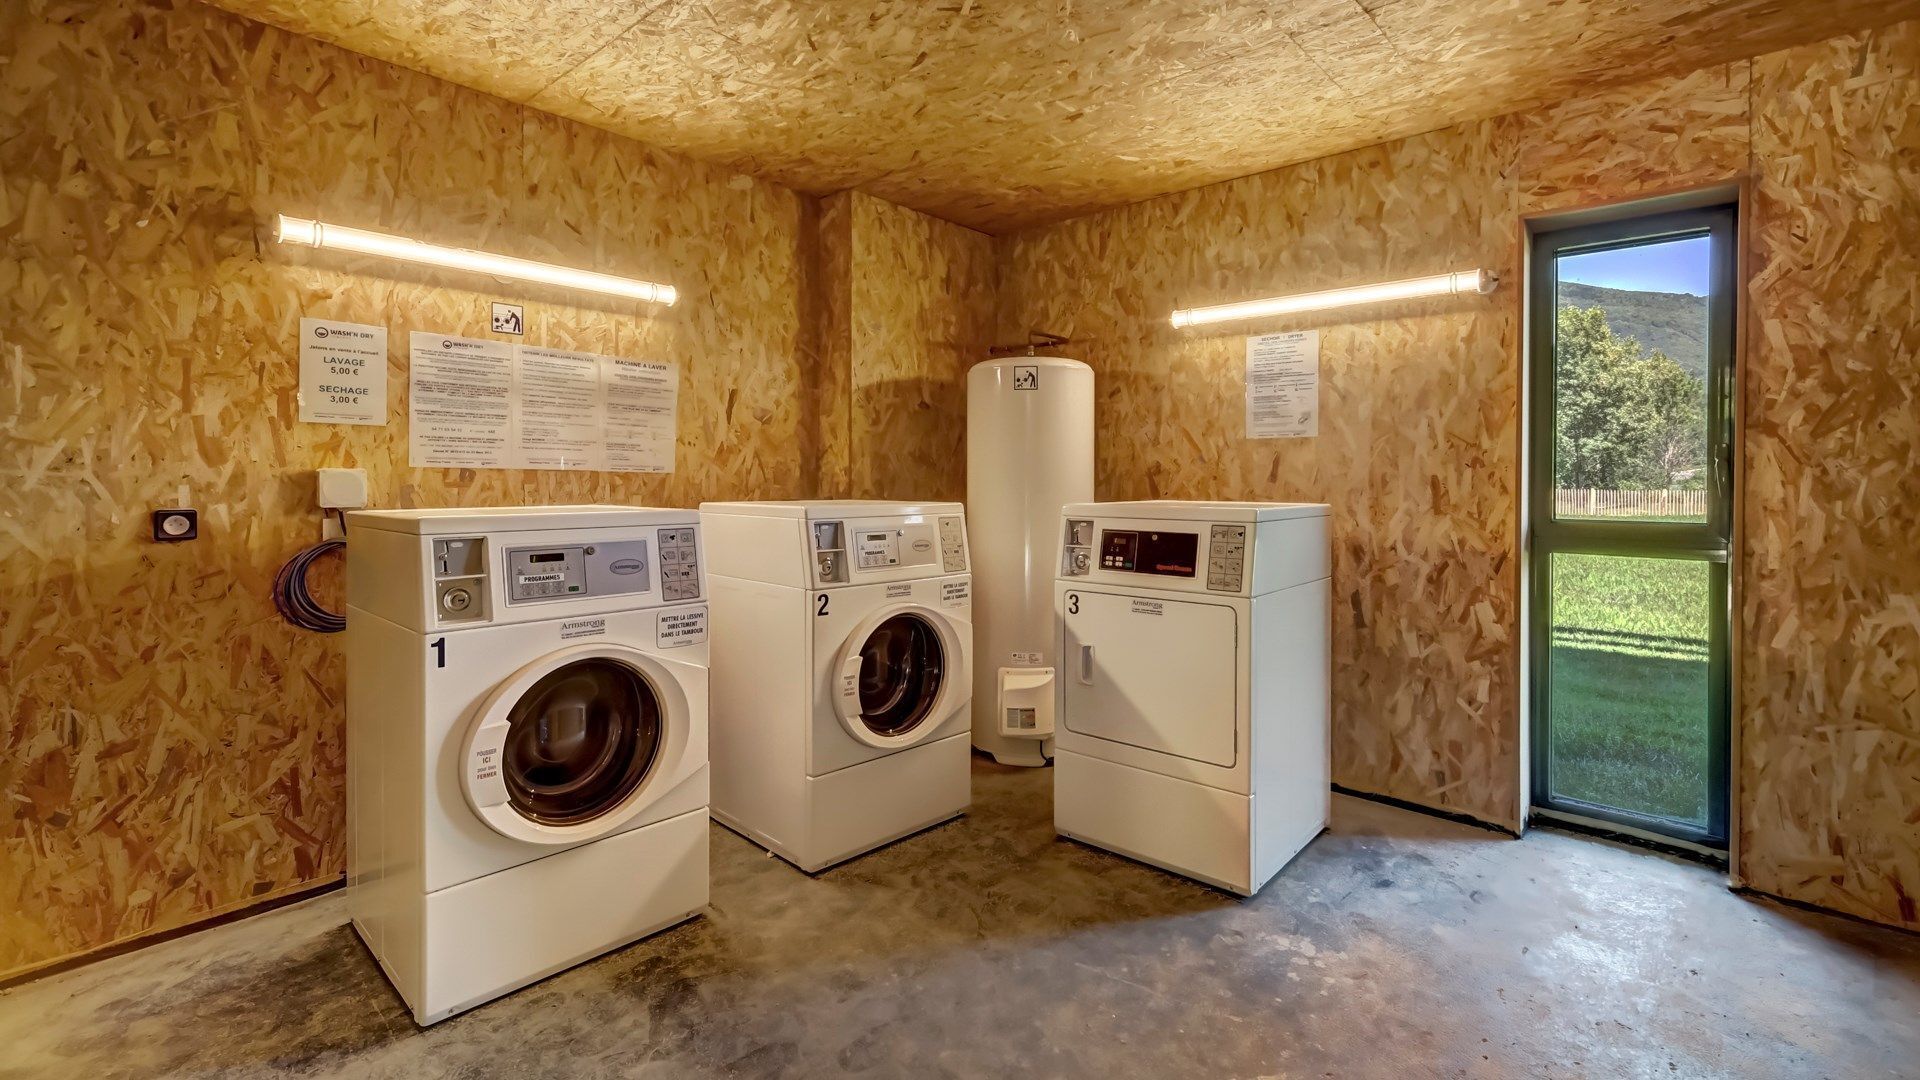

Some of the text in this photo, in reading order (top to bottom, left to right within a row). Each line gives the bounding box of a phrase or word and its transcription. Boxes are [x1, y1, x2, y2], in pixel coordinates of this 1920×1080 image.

[330, 329, 358, 337] WASH'N
[323, 356, 365, 366] LAVAGE
[615, 360, 641, 368] MACHINE
[330, 366, 350, 375] 5,00
[319, 385, 368, 395] SECHAGE
[330, 395, 350, 404] 3,00
[523, 574, 560, 582] PROGRAMMES
[817, 593, 829, 617] 2
[1068, 594, 1079, 614] 3
[1132, 600, 1163, 609] Armstrong
[660, 615, 679, 623] METTRE
[687, 612, 704, 620] LESSIVE
[561, 619, 605, 630] Armstrong
[667, 621, 698, 629] DIRECTEMENT
[430, 637, 446, 668] 1
[476, 748, 497, 757] POUSSER
[482, 756, 491, 764] ICI
[476, 771, 497, 779] FERMER
